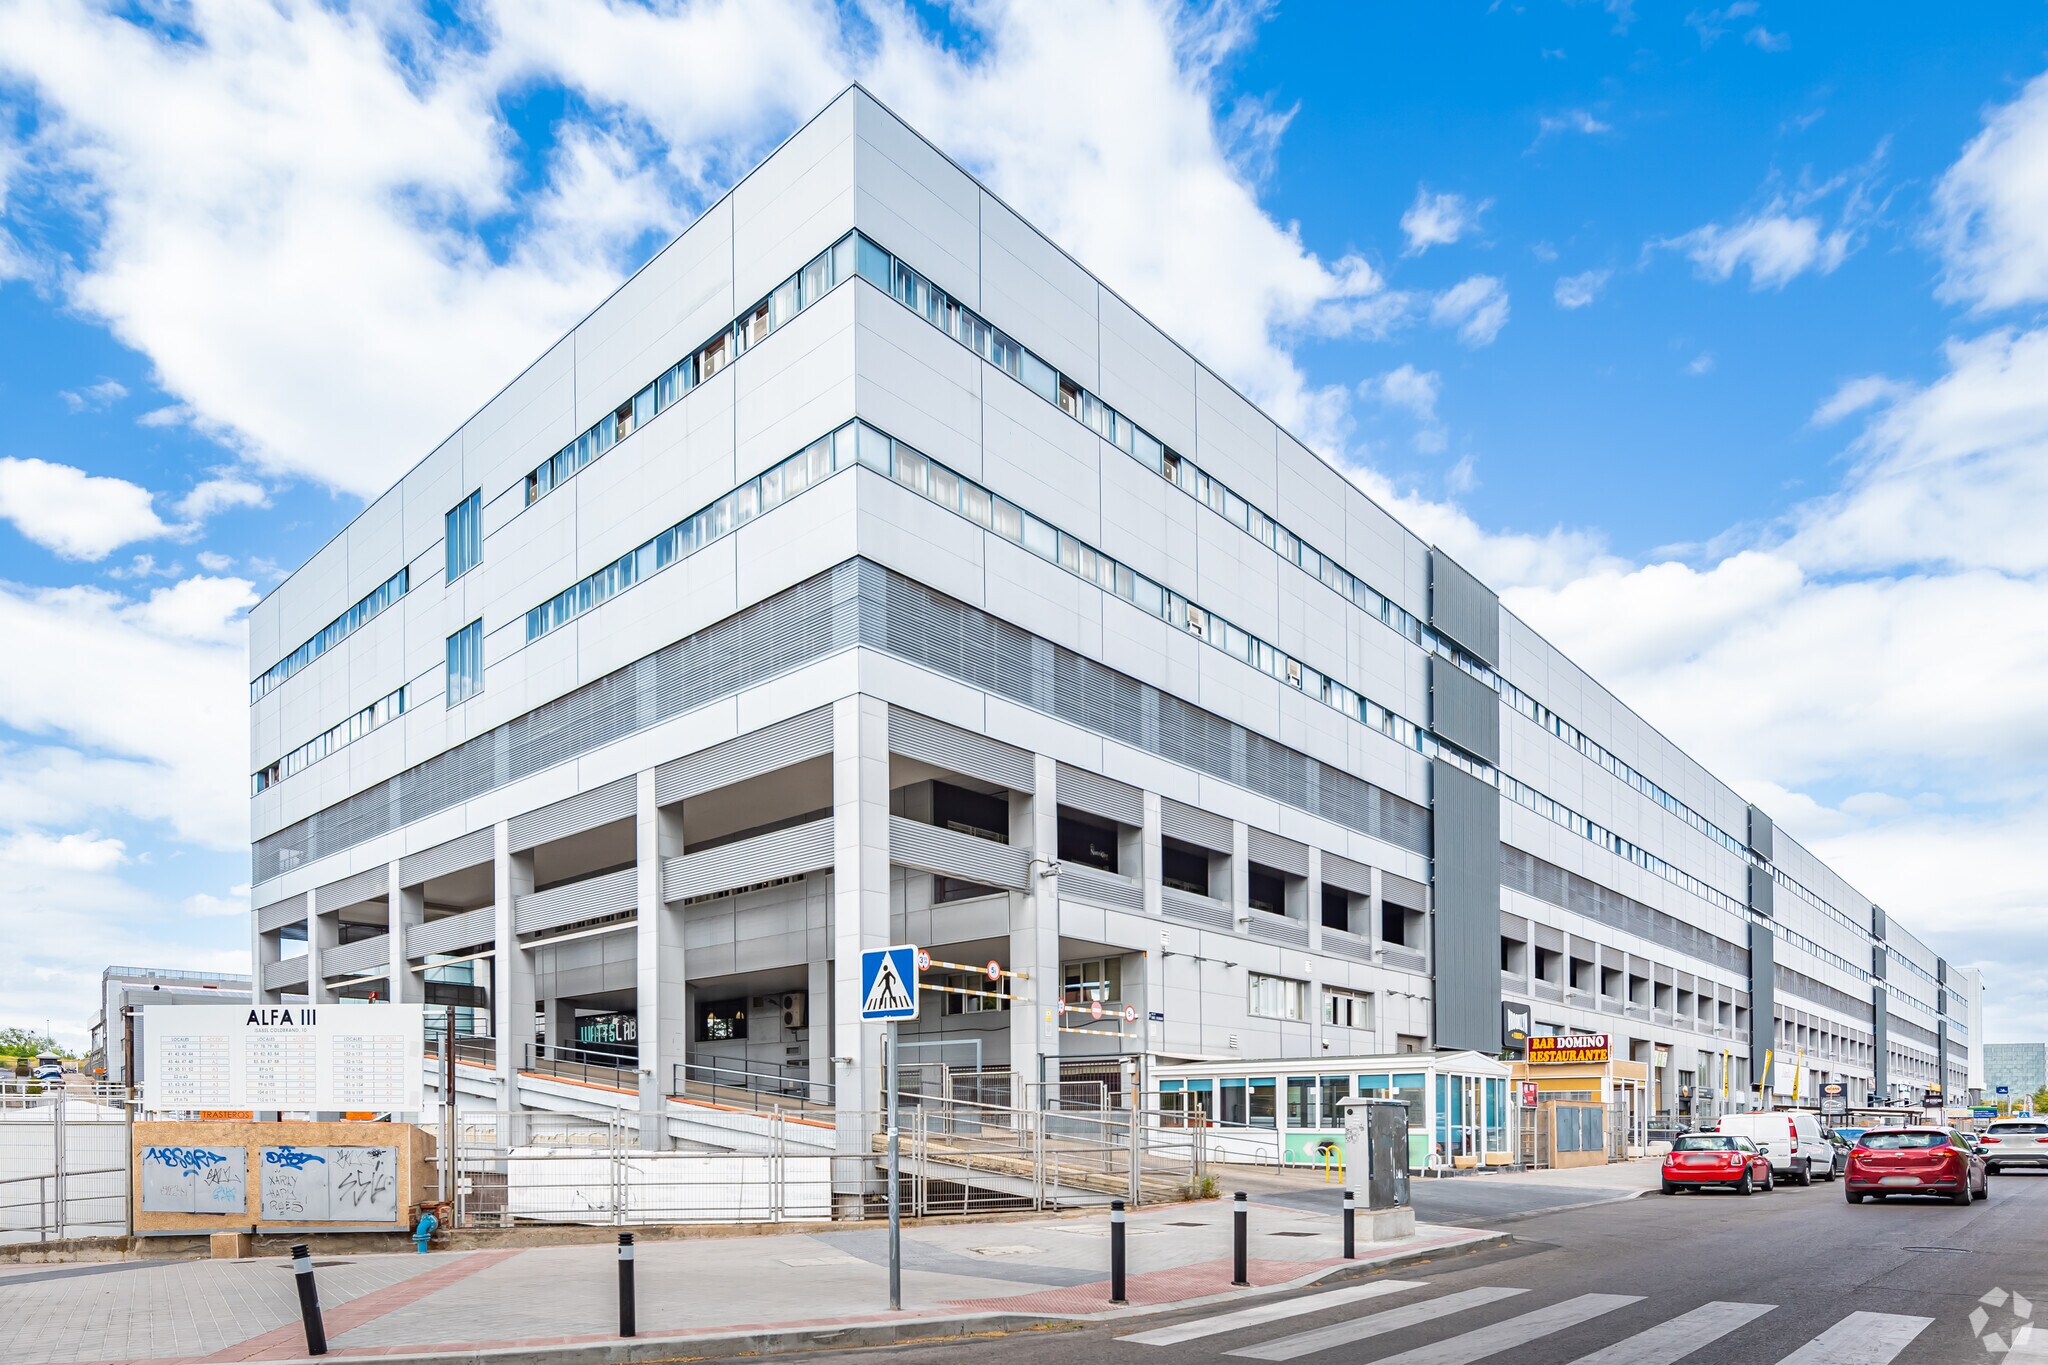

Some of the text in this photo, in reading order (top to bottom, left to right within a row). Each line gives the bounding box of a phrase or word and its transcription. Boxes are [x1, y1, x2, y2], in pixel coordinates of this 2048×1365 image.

[246, 1009, 316, 1026] ALFA III
[1532, 1035, 1605, 1049] BAR DOMINO
[1529, 1049, 1608, 1062] RESTAURANTE
[202, 1111, 250, 1119] TRASTEROS
